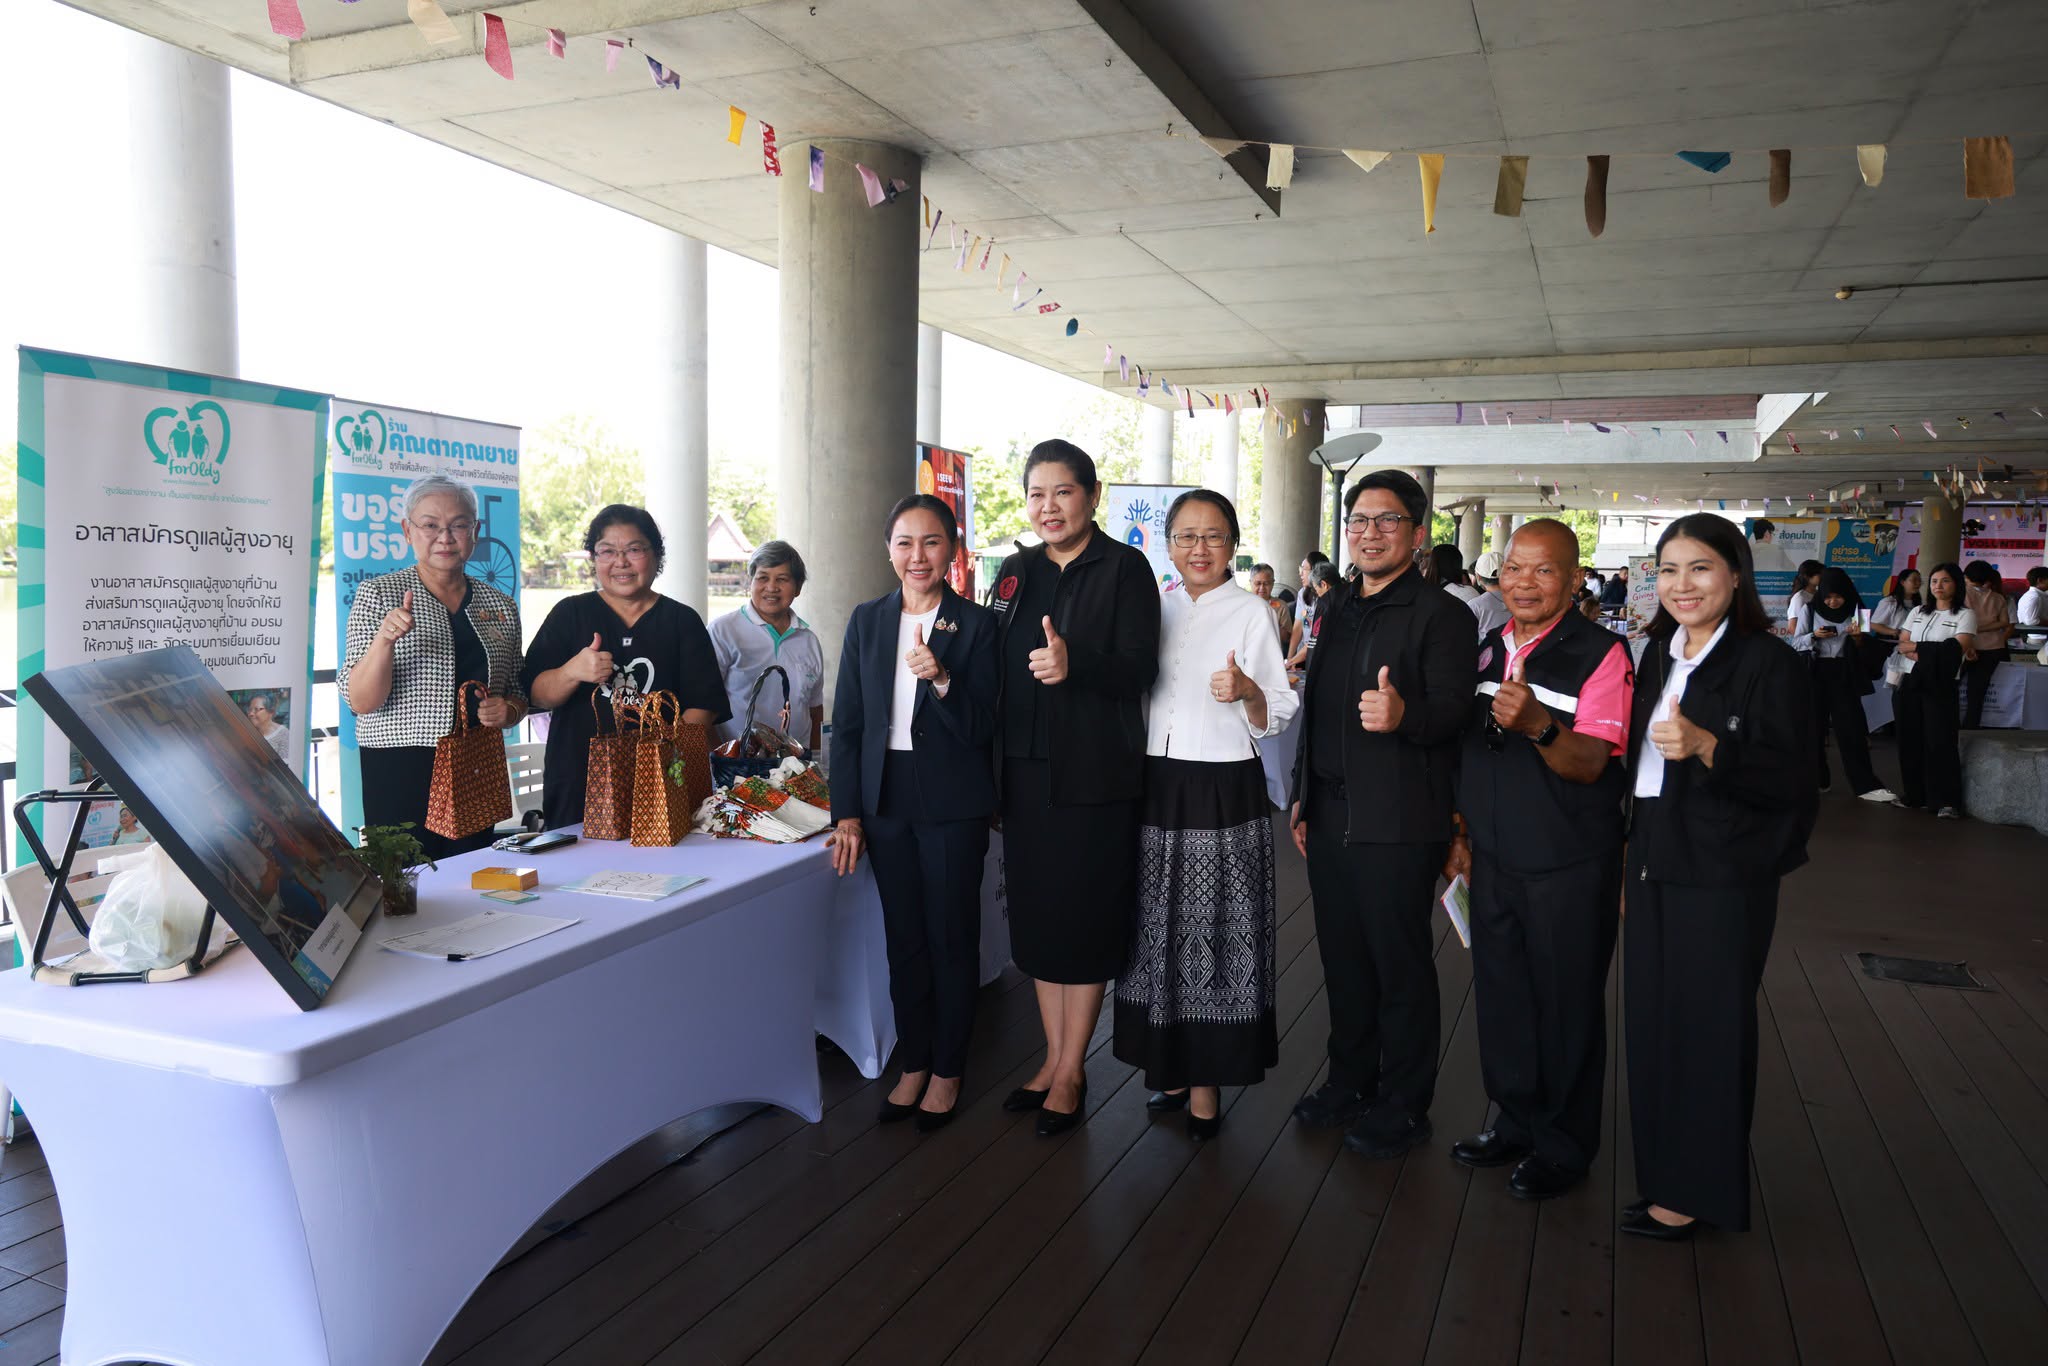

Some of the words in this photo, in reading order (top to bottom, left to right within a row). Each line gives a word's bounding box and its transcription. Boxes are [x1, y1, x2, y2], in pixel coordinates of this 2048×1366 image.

[388, 417, 408, 433] ร้าน
[389, 432, 518, 467] คุณตาคุณยาย
[167, 459, 221, 485] forOldy
[75, 523, 293, 556] อาสาสมัครดูแลผู้สูงอายุ
[1968, 539, 2040, 549] VOLUNTEER
[90, 574, 277, 594] งานอาสาสมัครดูแลผู้สูงอายุที่บ้าน
[1634, 583, 1655, 593] Craft
[85, 595, 224, 614] ส่งเสริมการดูแลผู้สูงอายุ
[226, 594, 281, 609] โดยจัดให้มี
[1632, 592, 1654, 601] Giving
[82, 613, 247, 633] อาสาสมัครดูแลผู้สูงอายุที่บ้าน
[251, 615, 283, 628] อบรม
[84, 636, 134, 654] ให้ความรู้
[138, 639, 158, 650] และ
